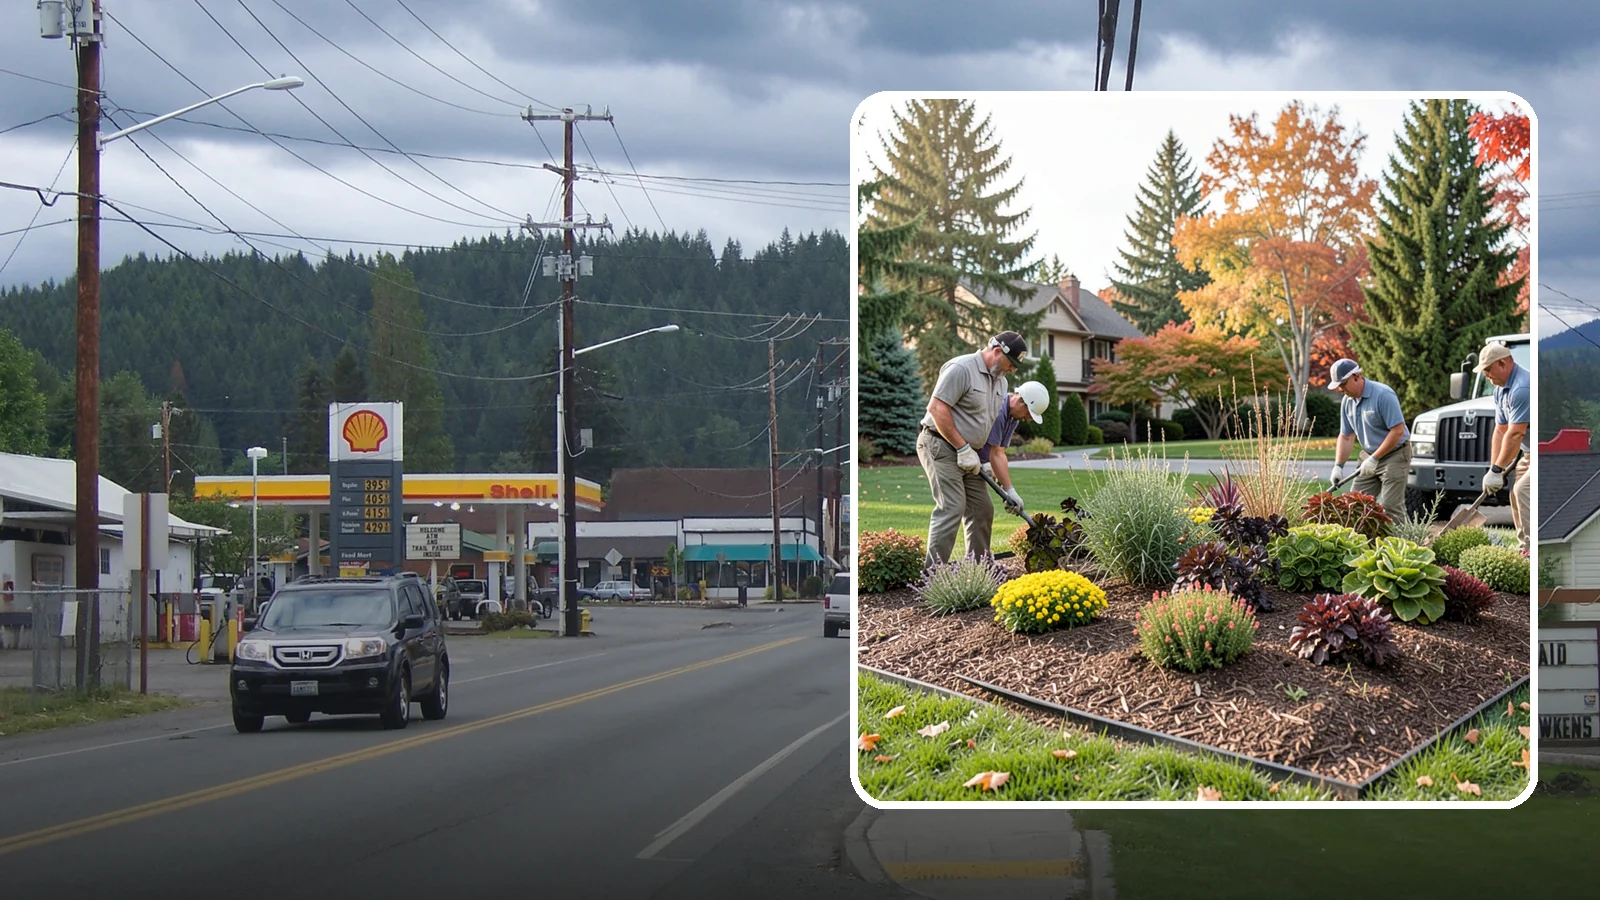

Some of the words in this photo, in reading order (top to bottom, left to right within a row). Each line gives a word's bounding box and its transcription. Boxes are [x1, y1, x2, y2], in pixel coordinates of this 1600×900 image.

[366, 479, 384, 490] 395
[490, 484, 547, 499] Shell
[366, 494, 384, 504] 405
[366, 508, 383, 518] 415
[366, 522, 383, 533] 429
